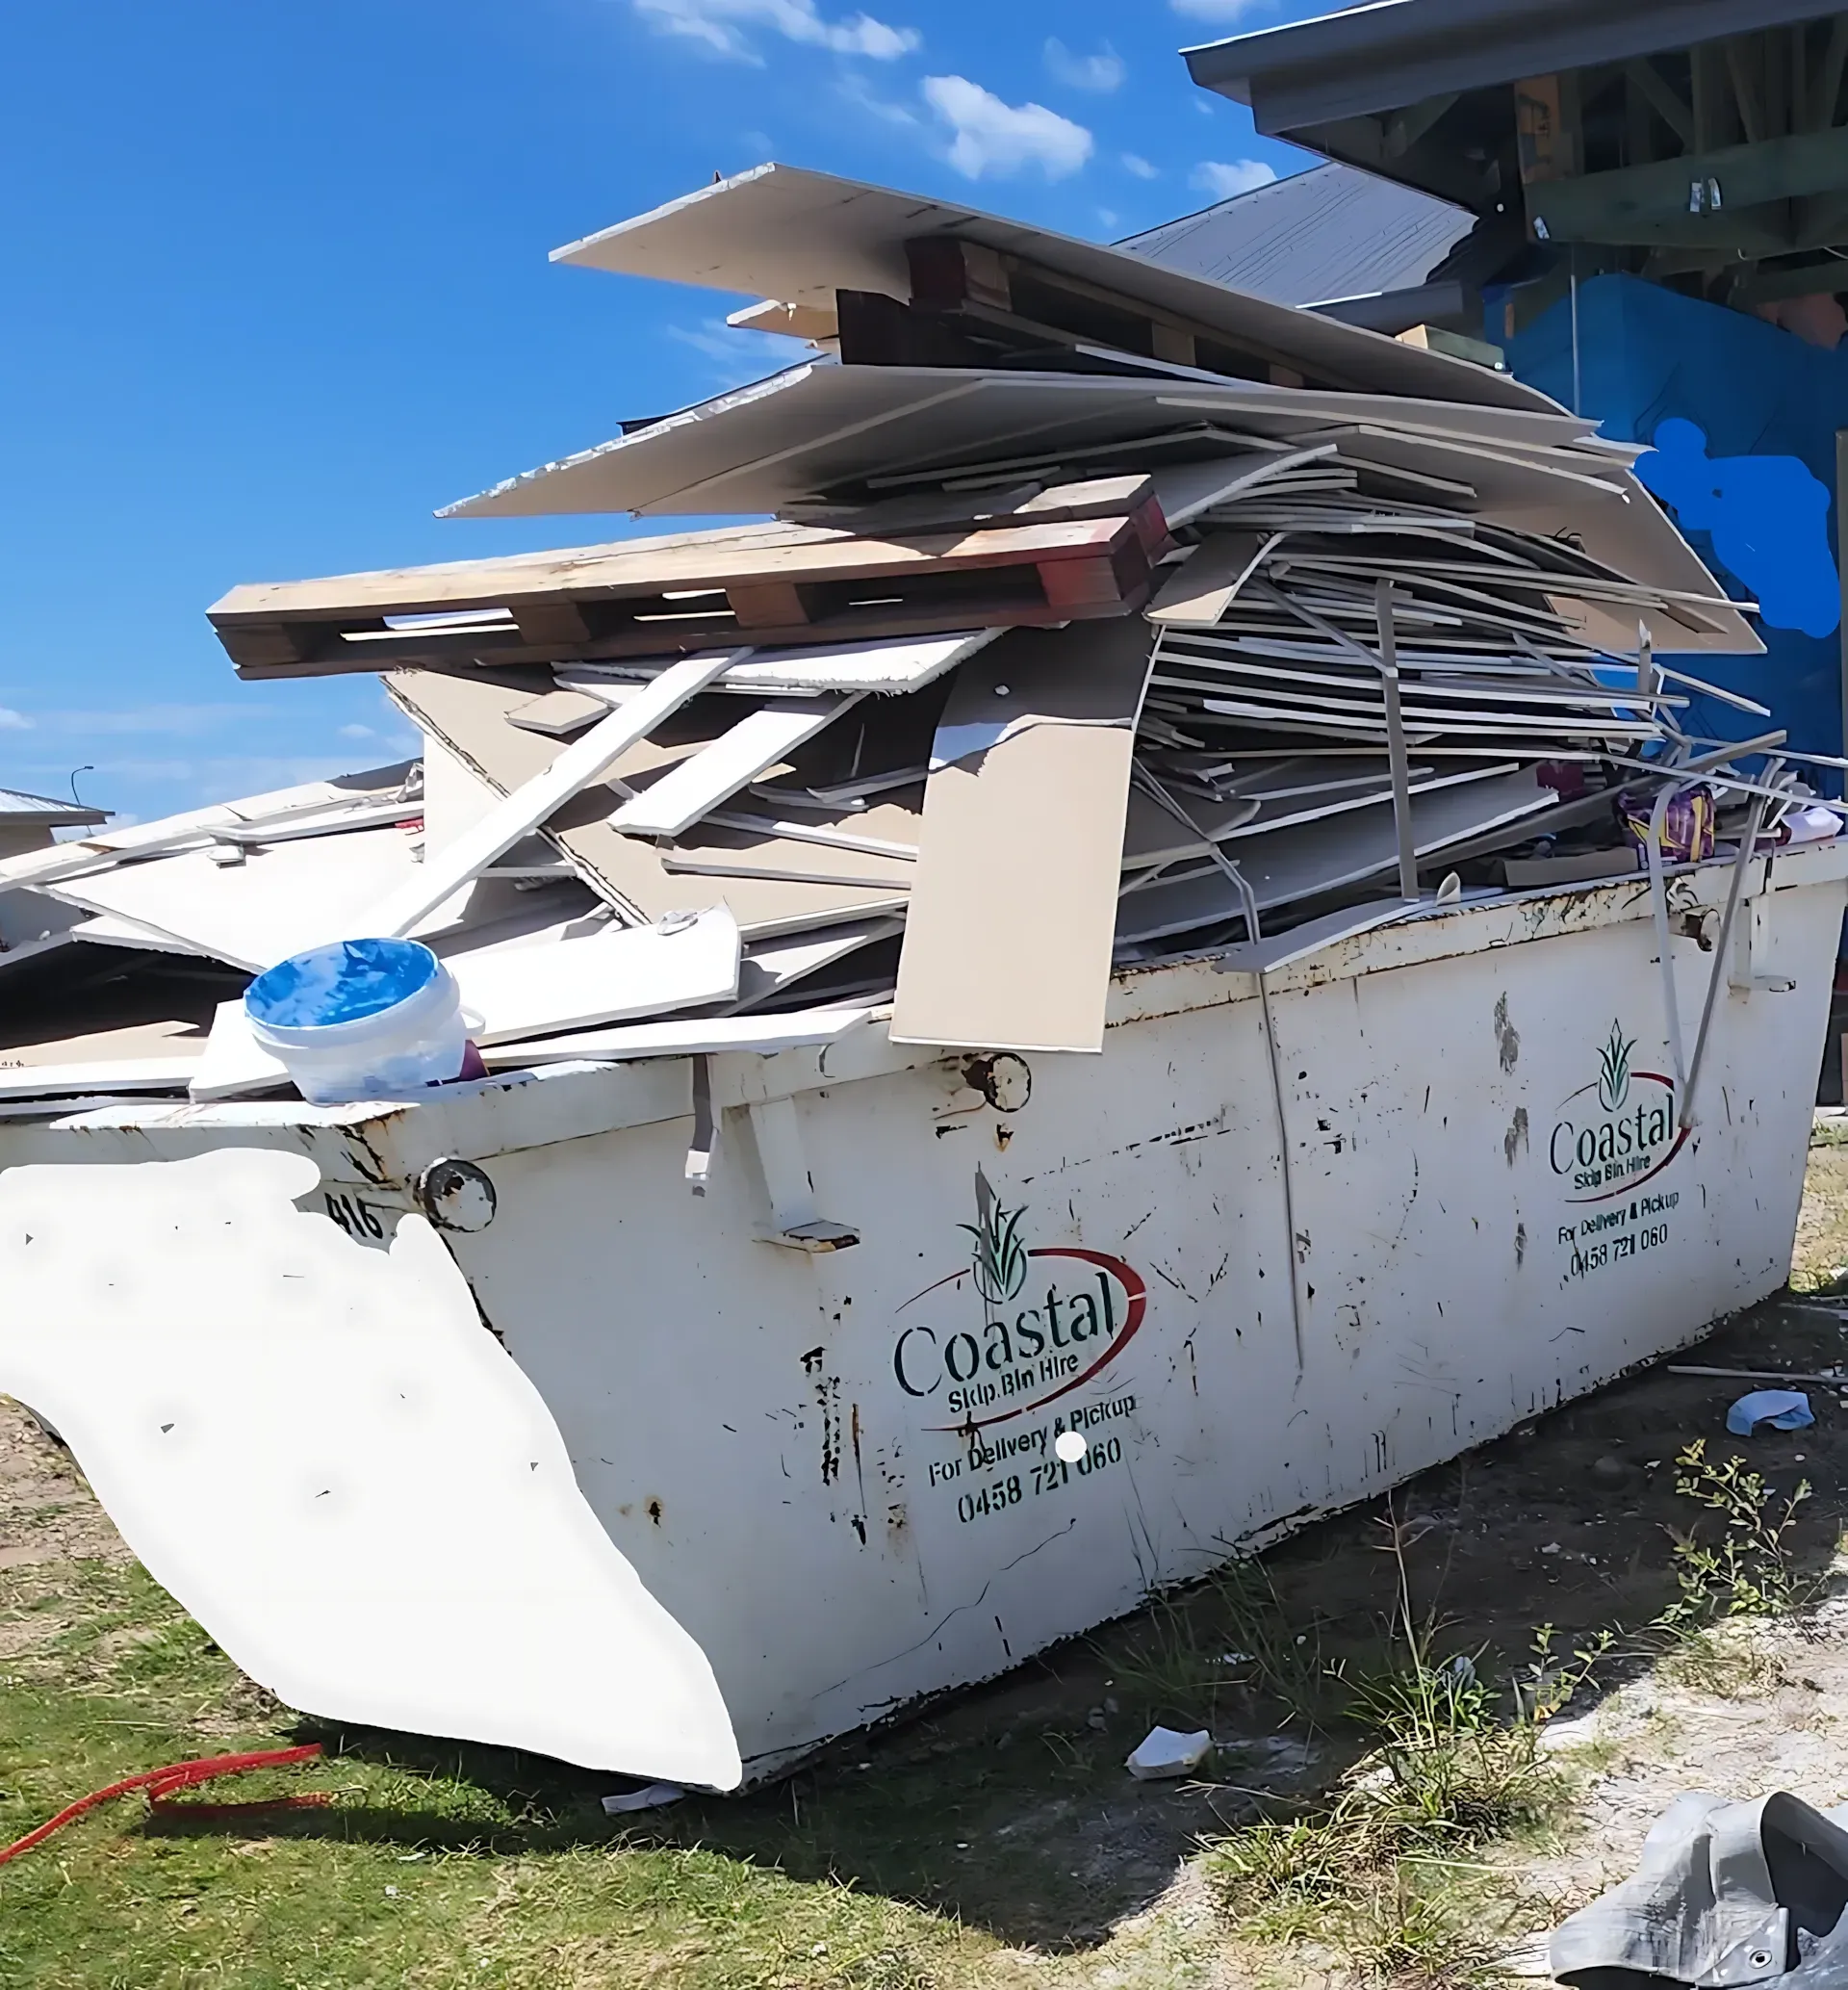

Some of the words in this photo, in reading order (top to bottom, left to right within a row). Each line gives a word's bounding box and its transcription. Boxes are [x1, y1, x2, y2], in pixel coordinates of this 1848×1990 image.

[1550, 1092, 1674, 1176] Coastal
[1574, 1169, 1602, 1190] Skip
[1604, 1163, 1625, 1181] Bin
[1627, 1155, 1651, 1175] Hire
[1558, 1226, 1578, 1245] For
[1580, 1208, 1627, 1236] Delivery
[1641, 1192, 1680, 1217] Pickup
[1571, 1243, 1607, 1277] 0458
[1612, 1233, 1635, 1262] 721
[1640, 1223, 1668, 1251] 060
[893, 1271, 1115, 1397] Coastal
[948, 1383, 996, 1413] Skip
[1000, 1368, 1035, 1396] Bin
[1039, 1354, 1079, 1383] Hire
[928, 1458, 962, 1487] For
[967, 1426, 1048, 1472] Delivery
[1069, 1395, 1137, 1433] Pickup
[958, 1474, 1023, 1523] 0458
[1029, 1459, 1069, 1496] 721
